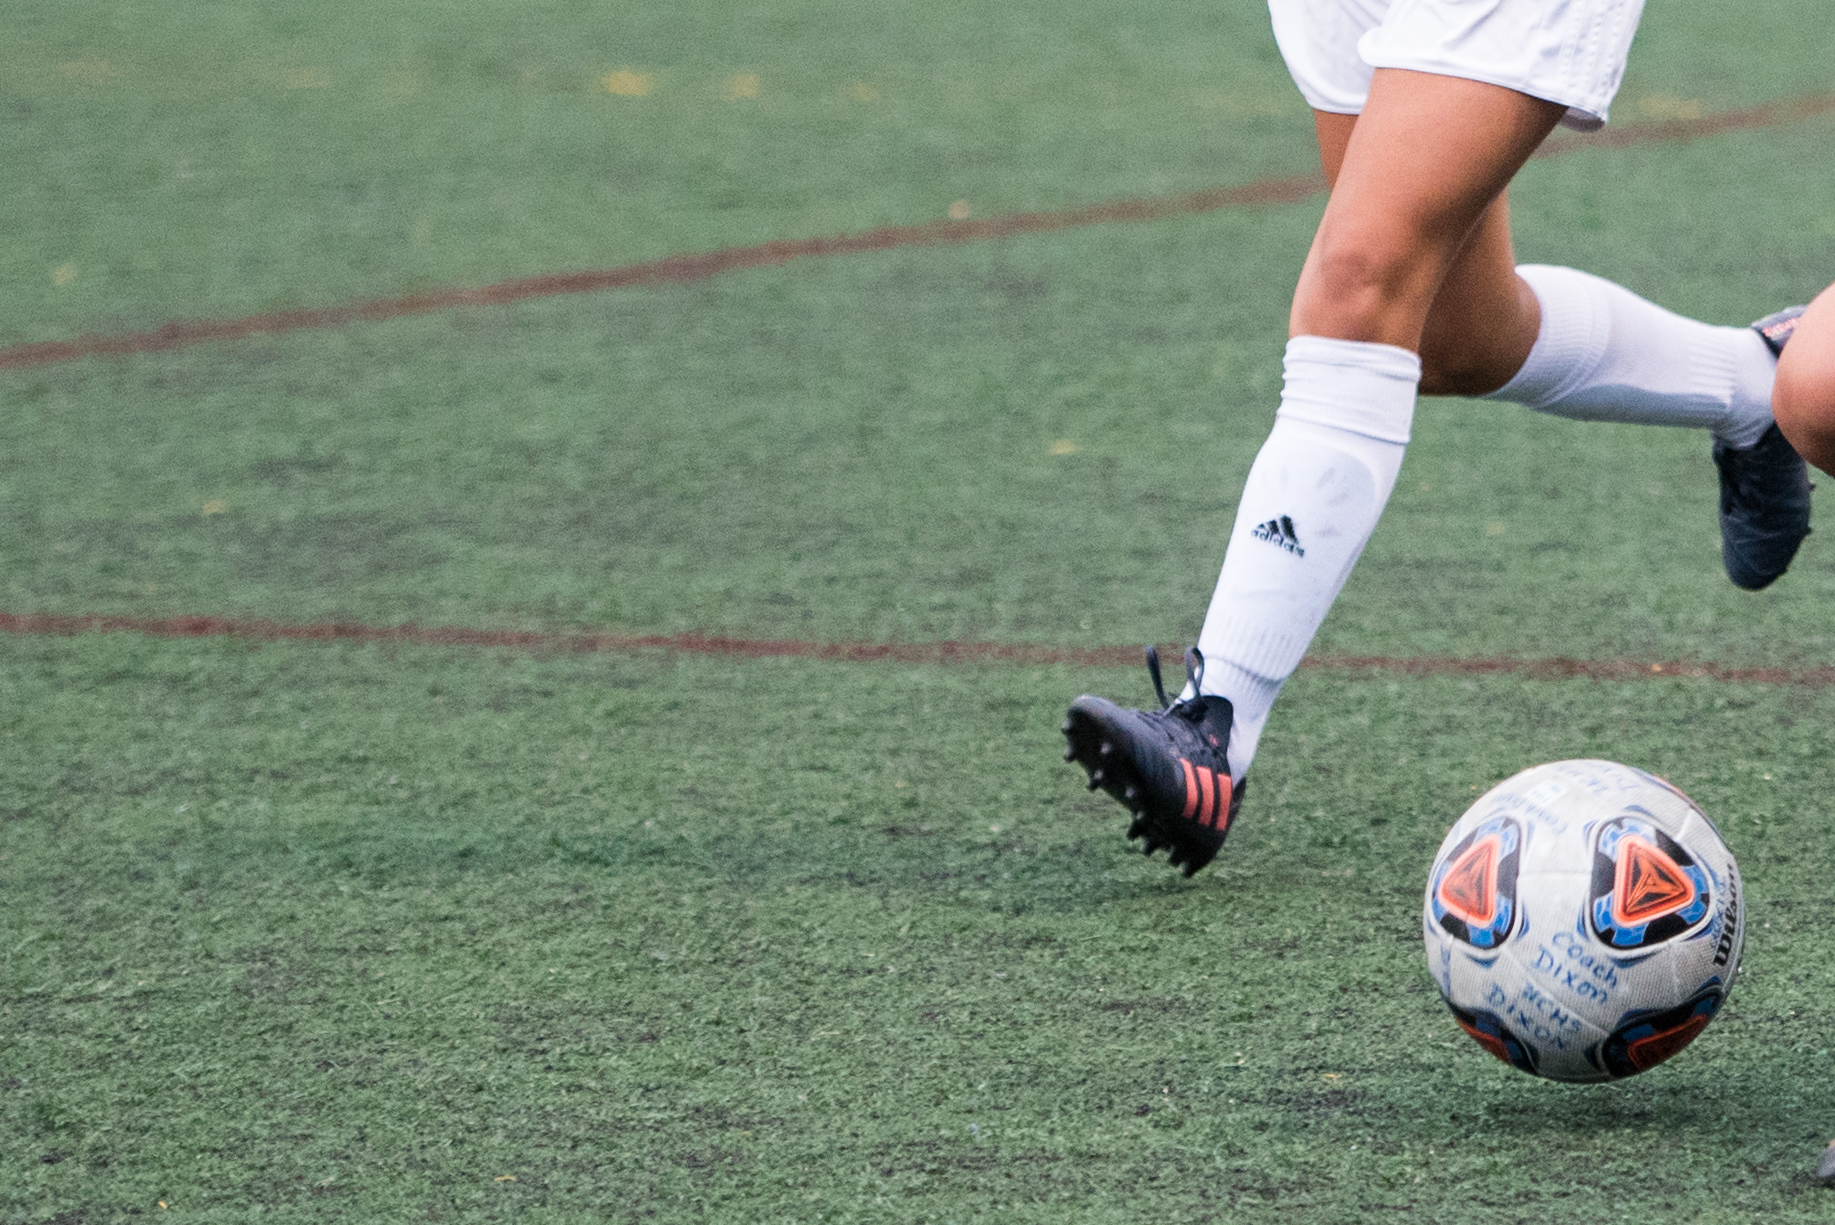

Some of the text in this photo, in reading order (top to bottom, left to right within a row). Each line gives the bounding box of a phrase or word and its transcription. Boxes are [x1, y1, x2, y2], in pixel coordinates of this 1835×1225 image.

[1251, 528, 1304, 558] adidas
[1531, 944, 1608, 1004] Dixon
[1552, 931, 1617, 988] Coach
